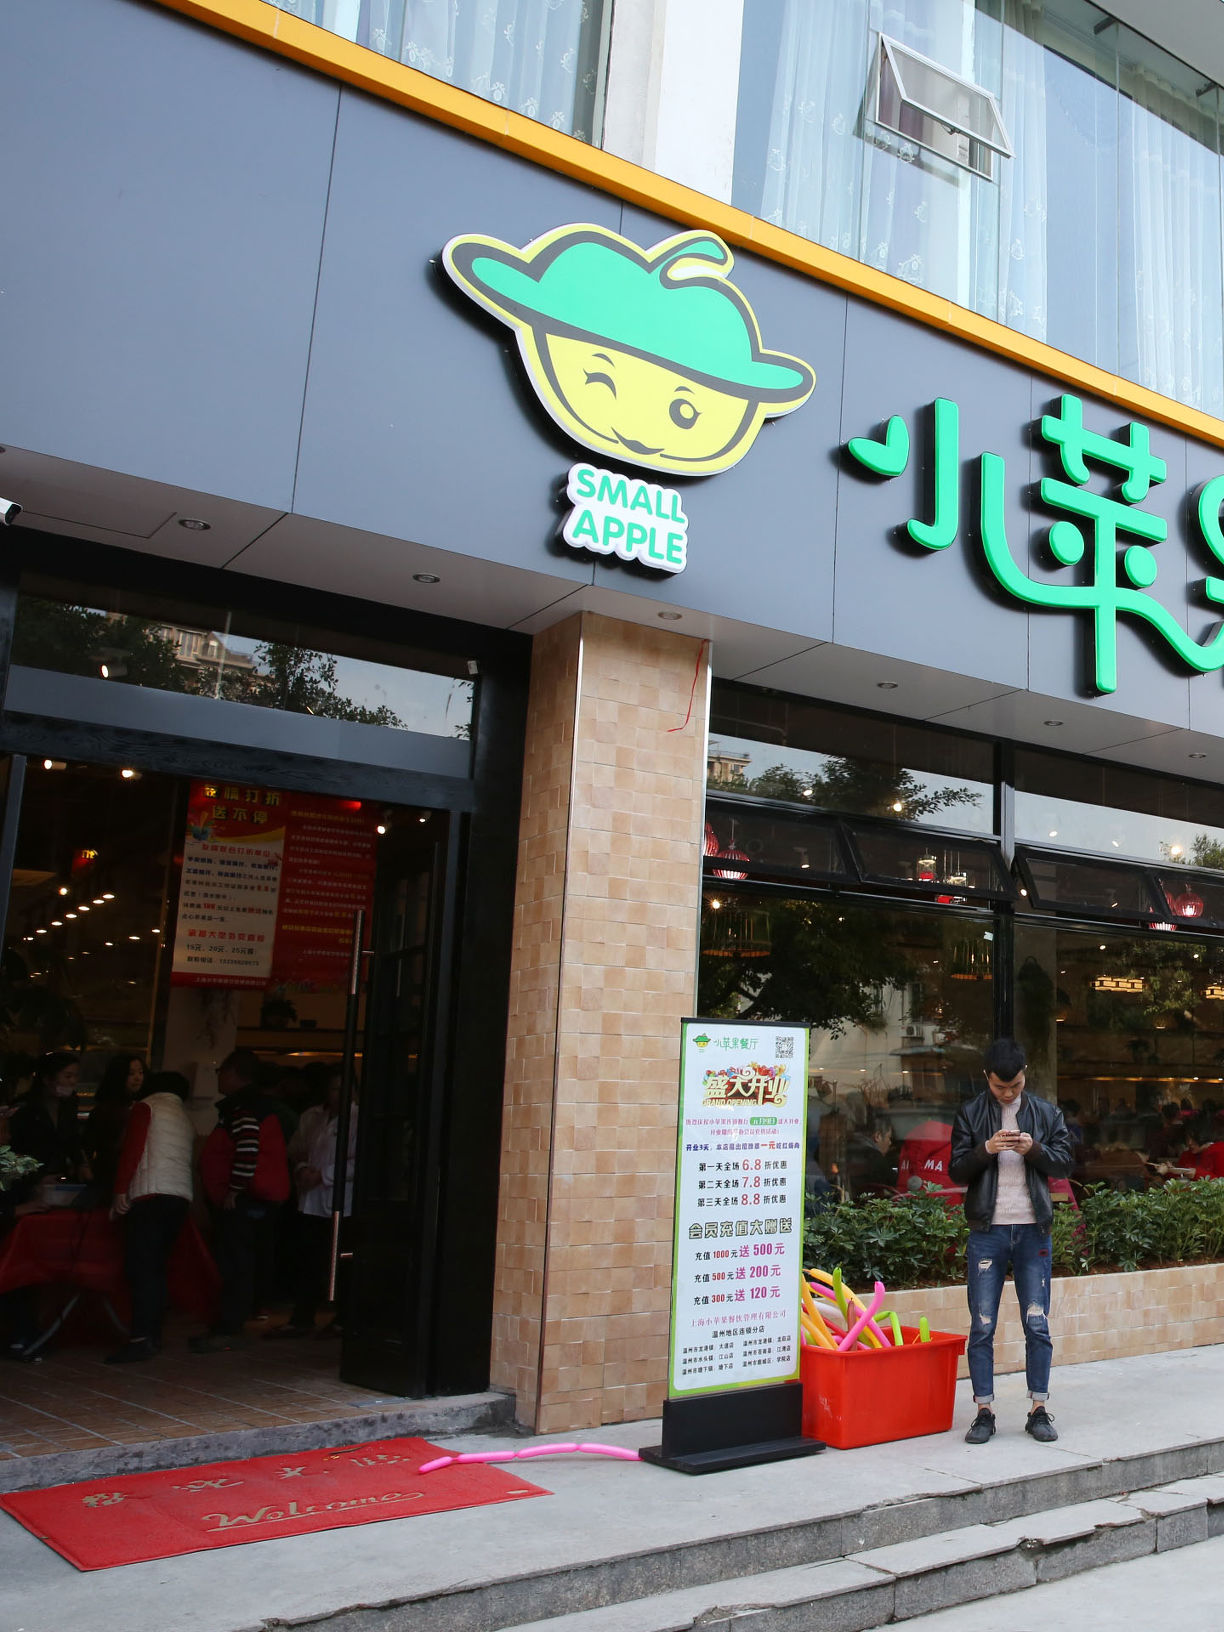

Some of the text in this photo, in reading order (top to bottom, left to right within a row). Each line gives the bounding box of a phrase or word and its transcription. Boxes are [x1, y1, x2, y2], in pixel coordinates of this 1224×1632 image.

[575, 467, 686, 525] SMALL
[571, 508, 685, 566] APPLE
[713, 1036, 760, 1052] 小苹果餐厅
[702, 1070, 791, 1107] 盛大开业
[688, 1217, 793, 1240] 会员充值大赠送
